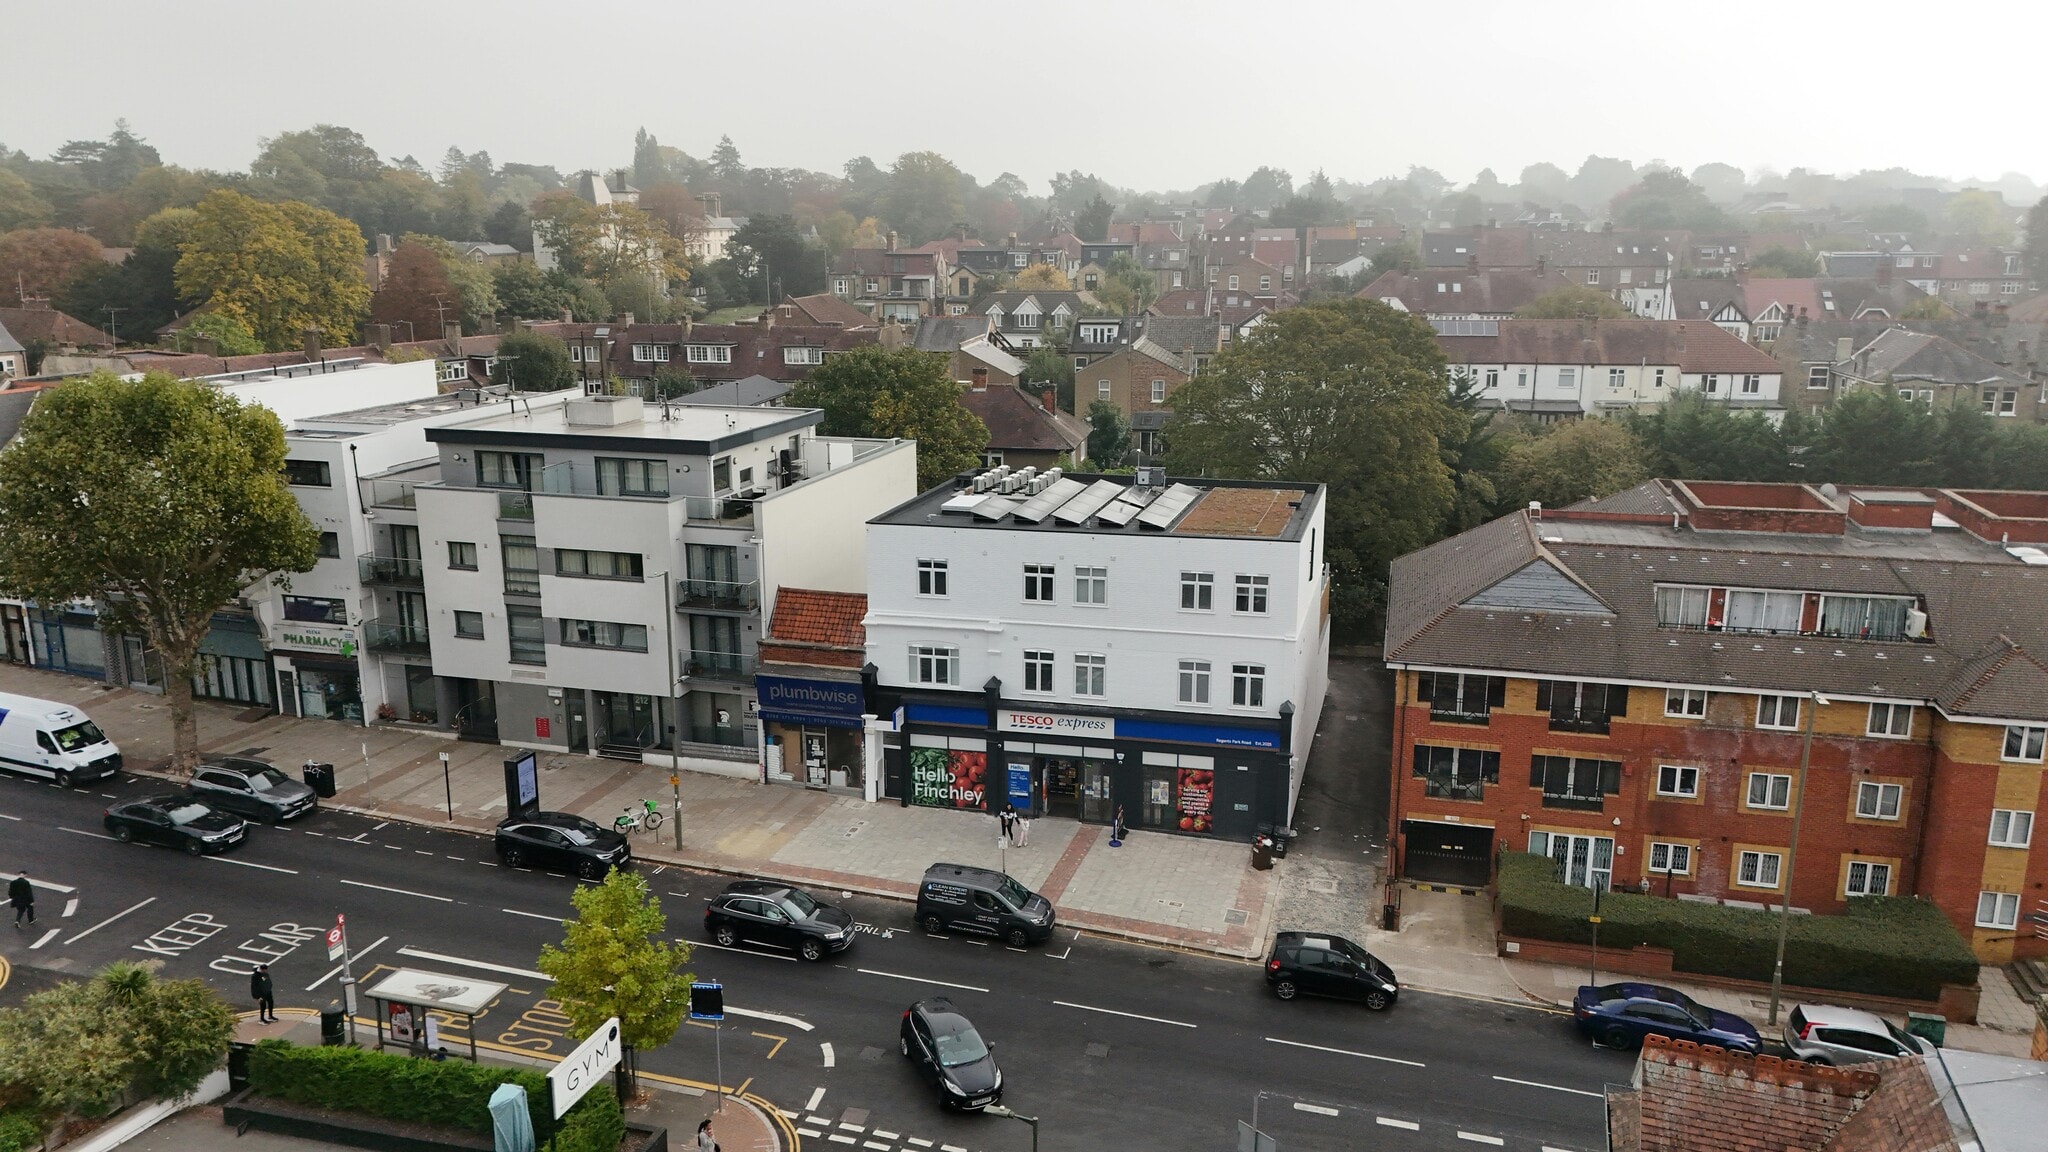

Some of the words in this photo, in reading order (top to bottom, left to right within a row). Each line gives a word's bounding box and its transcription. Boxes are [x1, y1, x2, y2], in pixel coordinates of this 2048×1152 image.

[283, 633, 343, 648] PHARMACY
[635, 696, 649, 705] 212
[769, 683, 857, 704] plumbwise
[1010, 714, 1053, 726] TESCO
[1057, 717, 1106, 730] express
[914, 766, 956, 783] Hello
[914, 783, 982, 805] Finchley
[131, 913, 228, 956] KEEP
[209, 922, 326, 975] CLEAR
[498, 1000, 576, 1051] STOP
[567, 1040, 609, 1091] GYM
